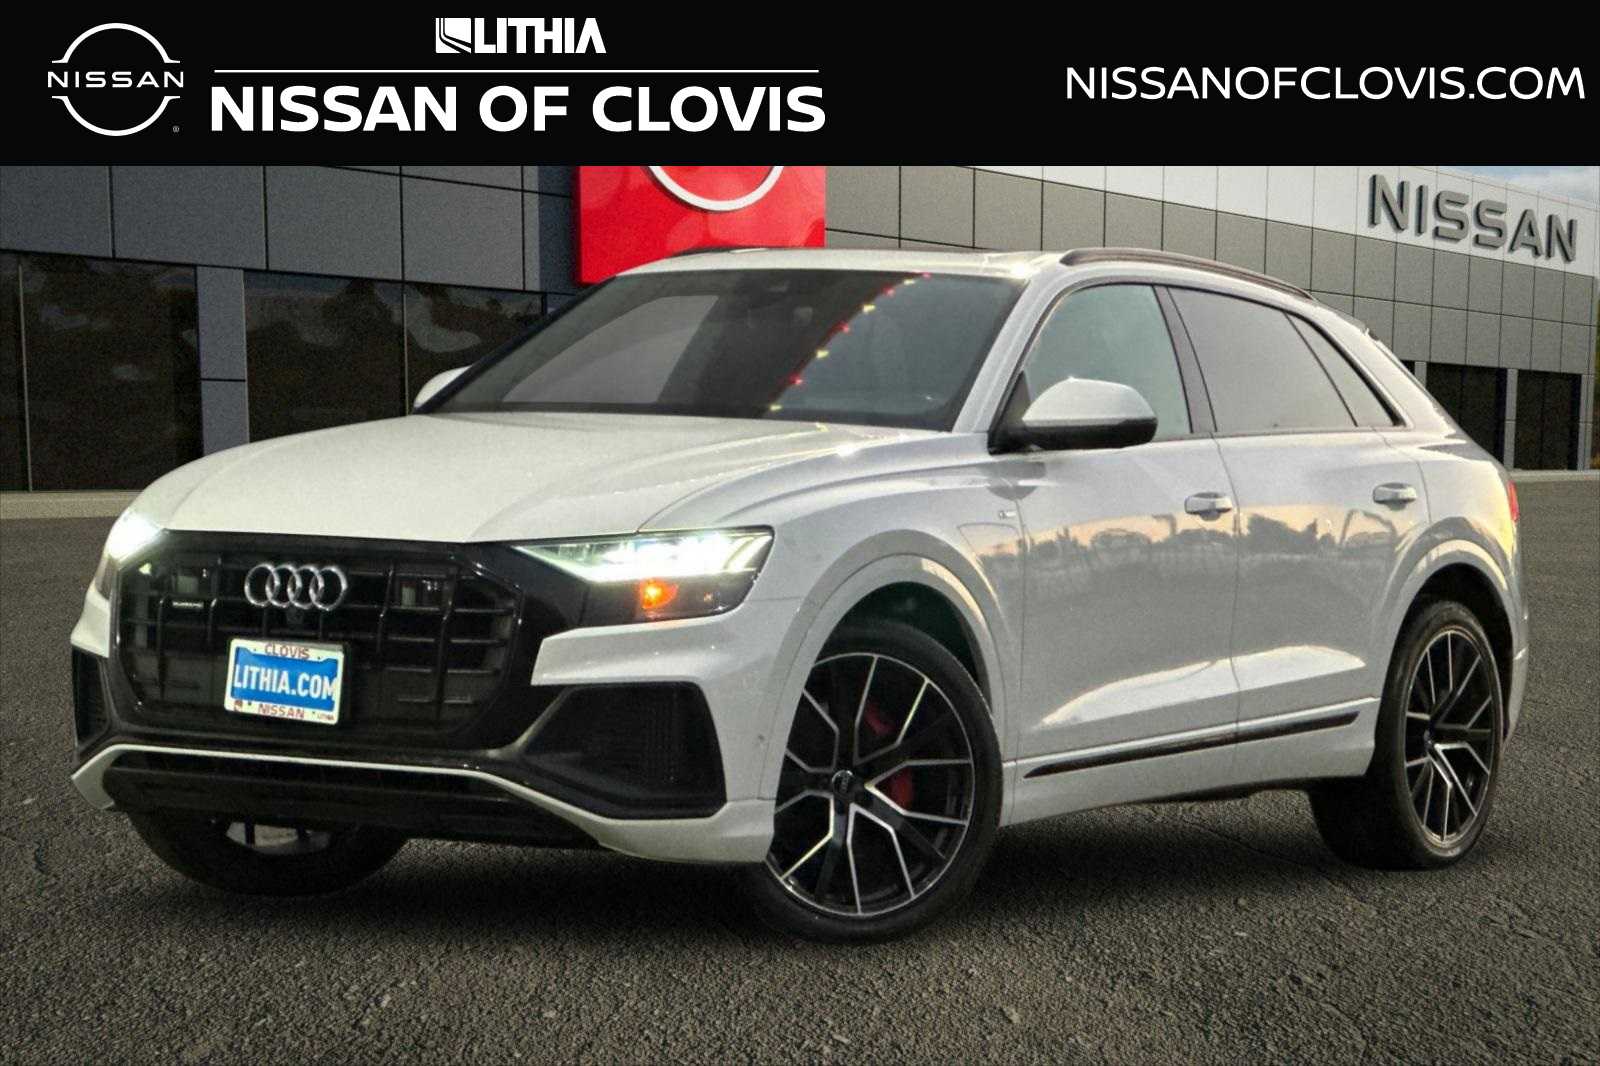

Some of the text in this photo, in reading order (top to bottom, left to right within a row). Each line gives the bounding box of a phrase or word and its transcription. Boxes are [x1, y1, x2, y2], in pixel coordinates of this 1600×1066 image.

[1367, 173, 1578, 265] NISSAN
[264, 642, 310, 659] CLOVIS
[233, 664, 338, 701] LITHIA.COM
[257, 702, 305, 719] NISSAN
